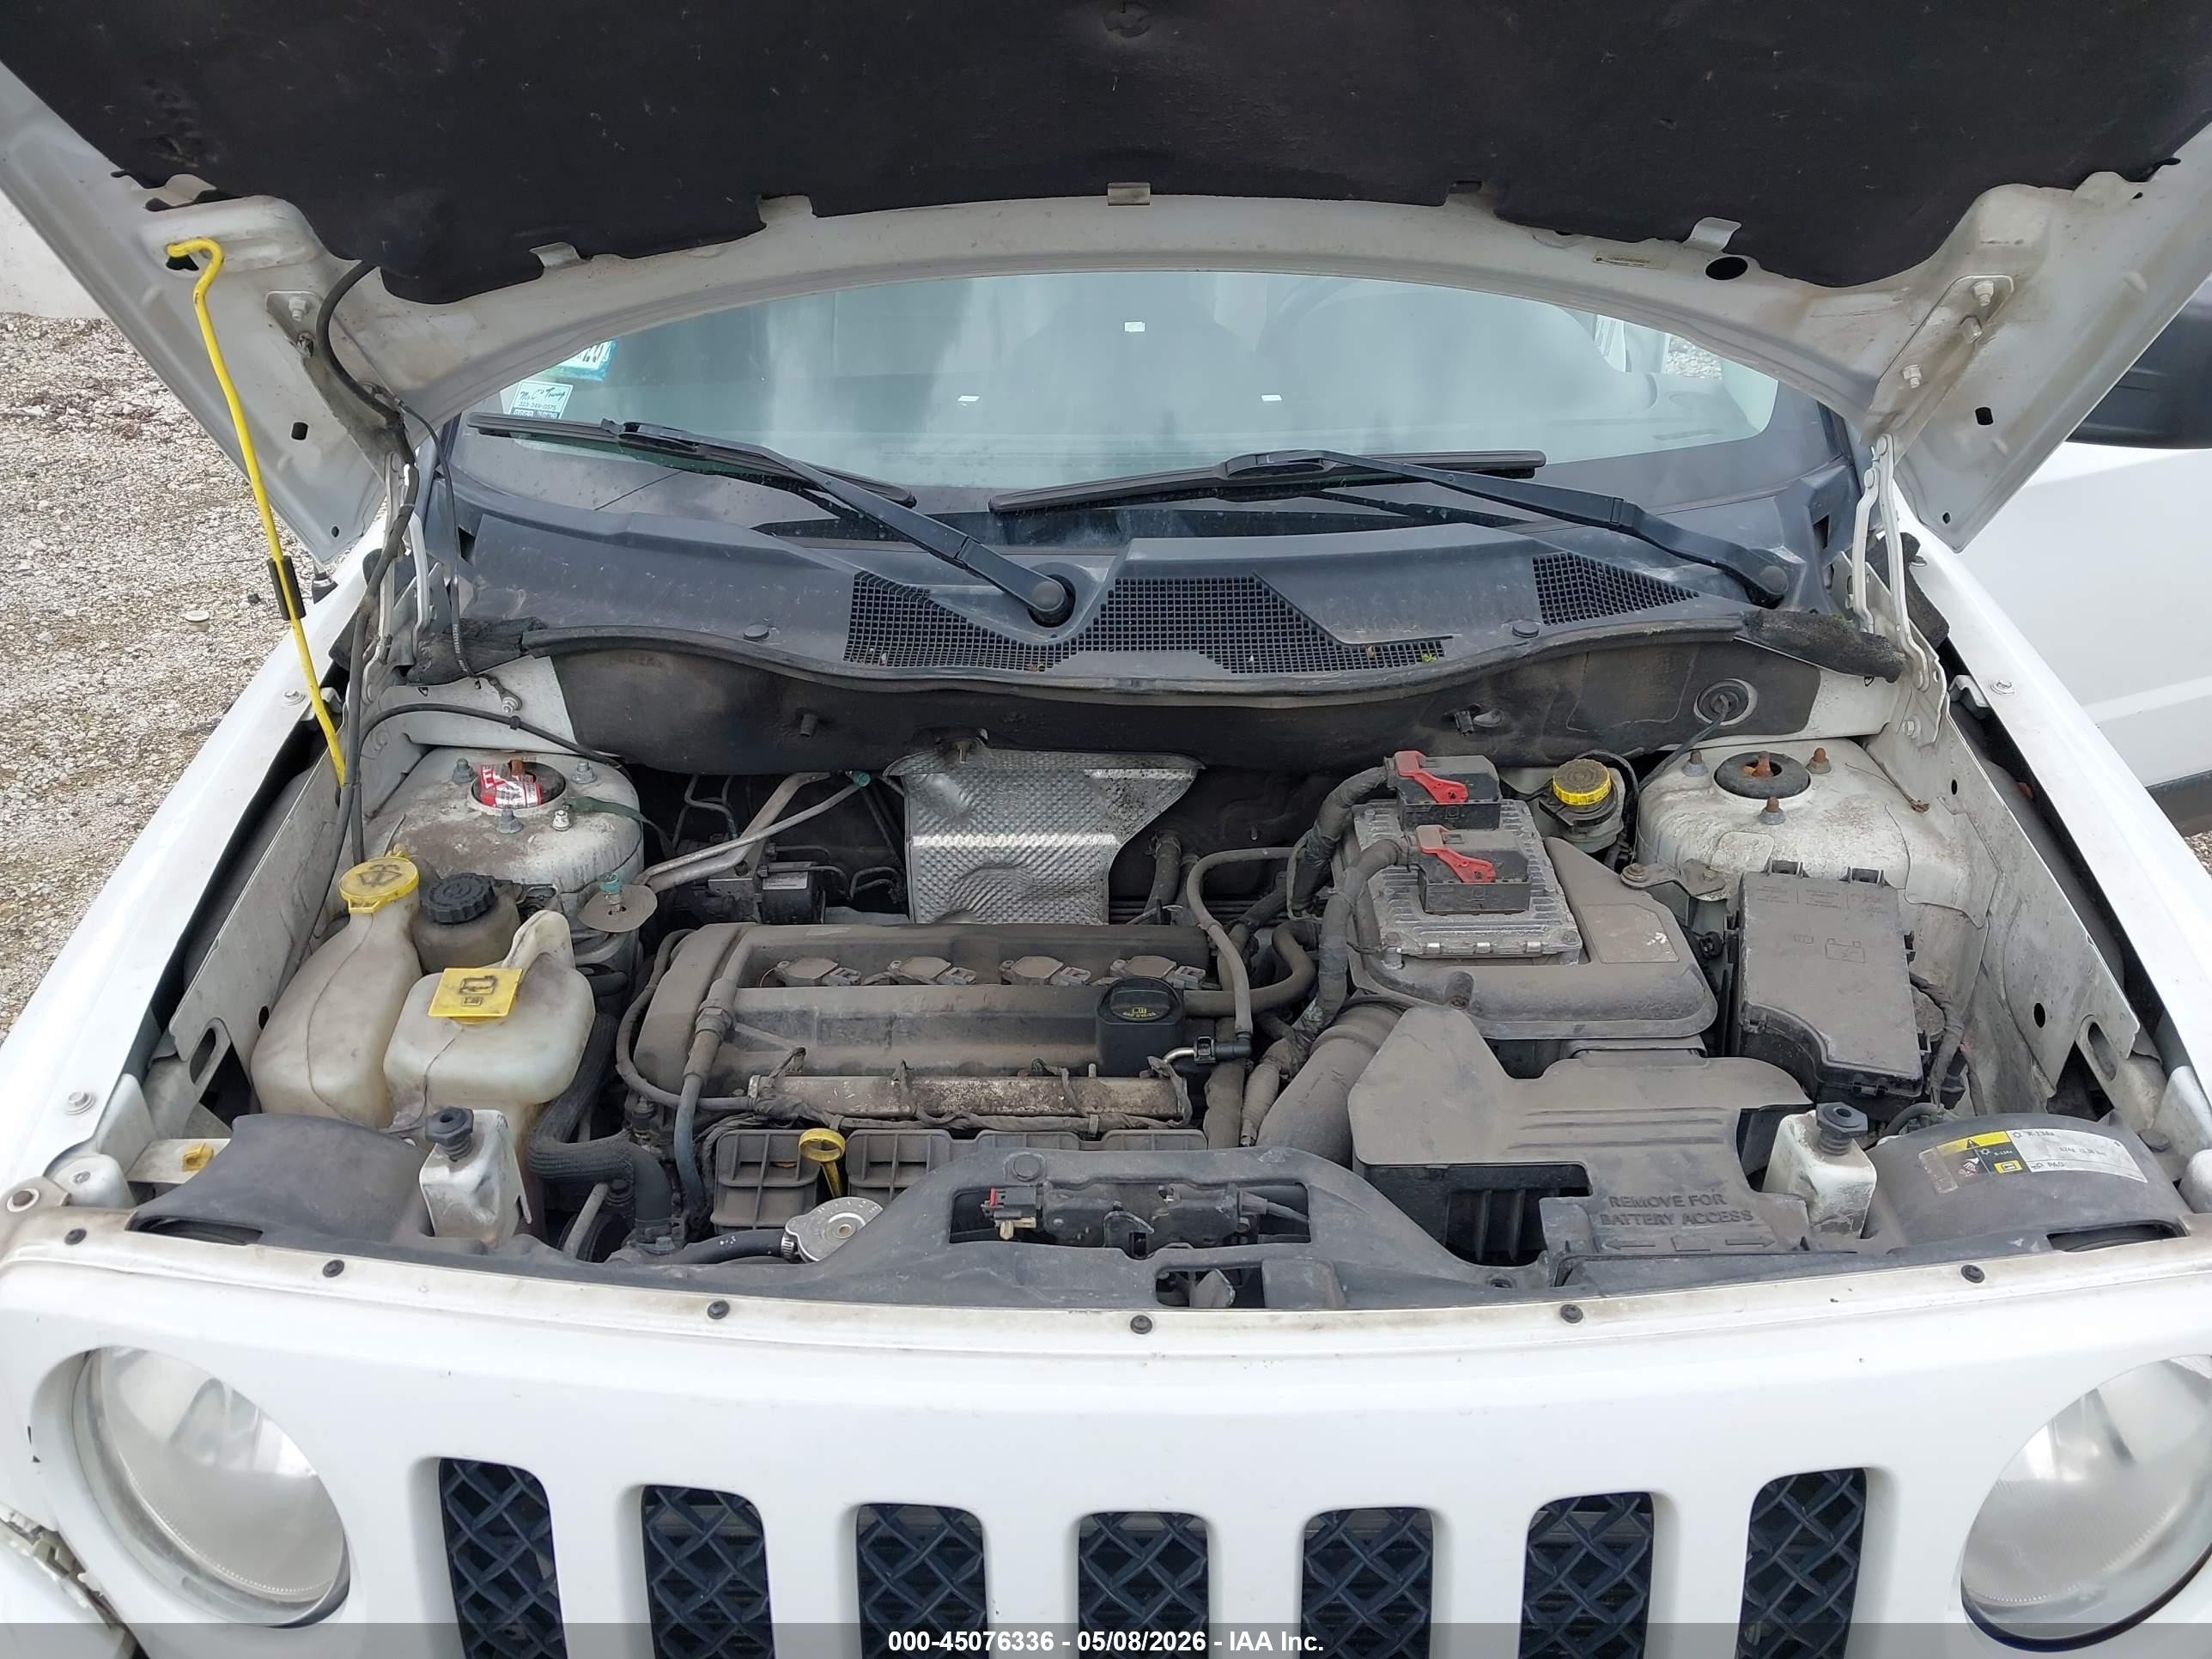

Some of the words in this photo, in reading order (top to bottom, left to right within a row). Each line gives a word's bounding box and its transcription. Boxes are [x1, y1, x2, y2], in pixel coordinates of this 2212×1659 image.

[1608, 1194, 1685, 1209] REMOVE
[1689, 1193, 1726, 1206] FOR
[1600, 1212, 1675, 1226] BATTERY
[1682, 1209, 1754, 1224] ACCESS
